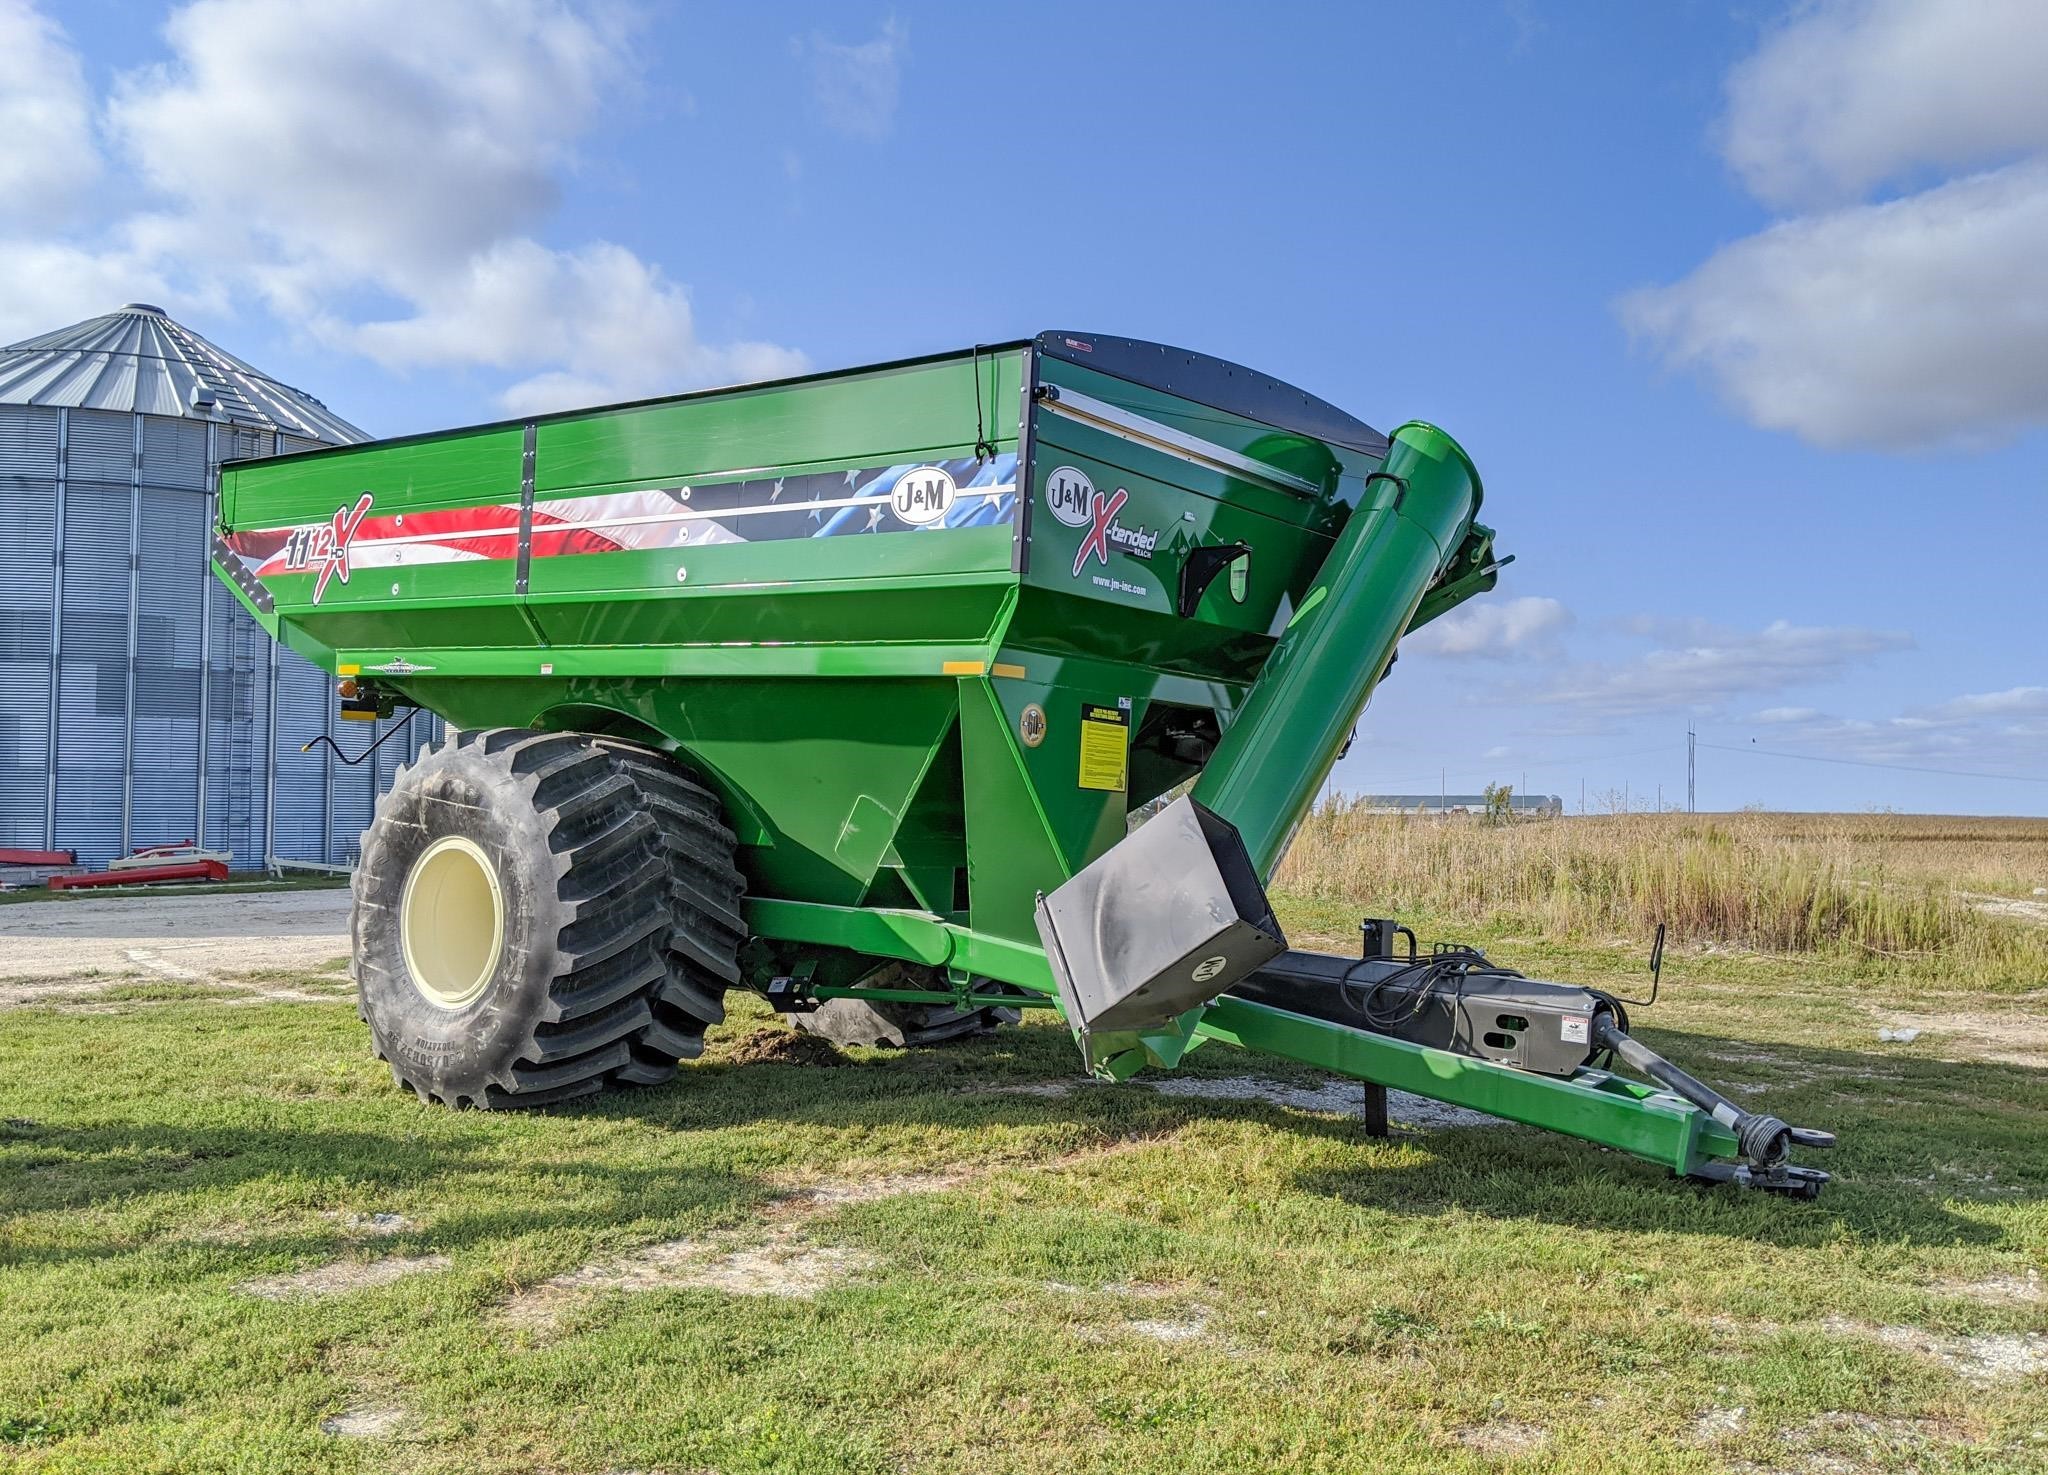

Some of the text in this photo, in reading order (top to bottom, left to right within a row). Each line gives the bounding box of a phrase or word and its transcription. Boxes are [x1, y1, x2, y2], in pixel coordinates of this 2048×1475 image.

[897, 479, 946, 513] J&M
[1051, 477, 1089, 516] J&M
[330, 547, 346, 559] HD
[1092, 575, 1147, 596] www.jm-inc.com
